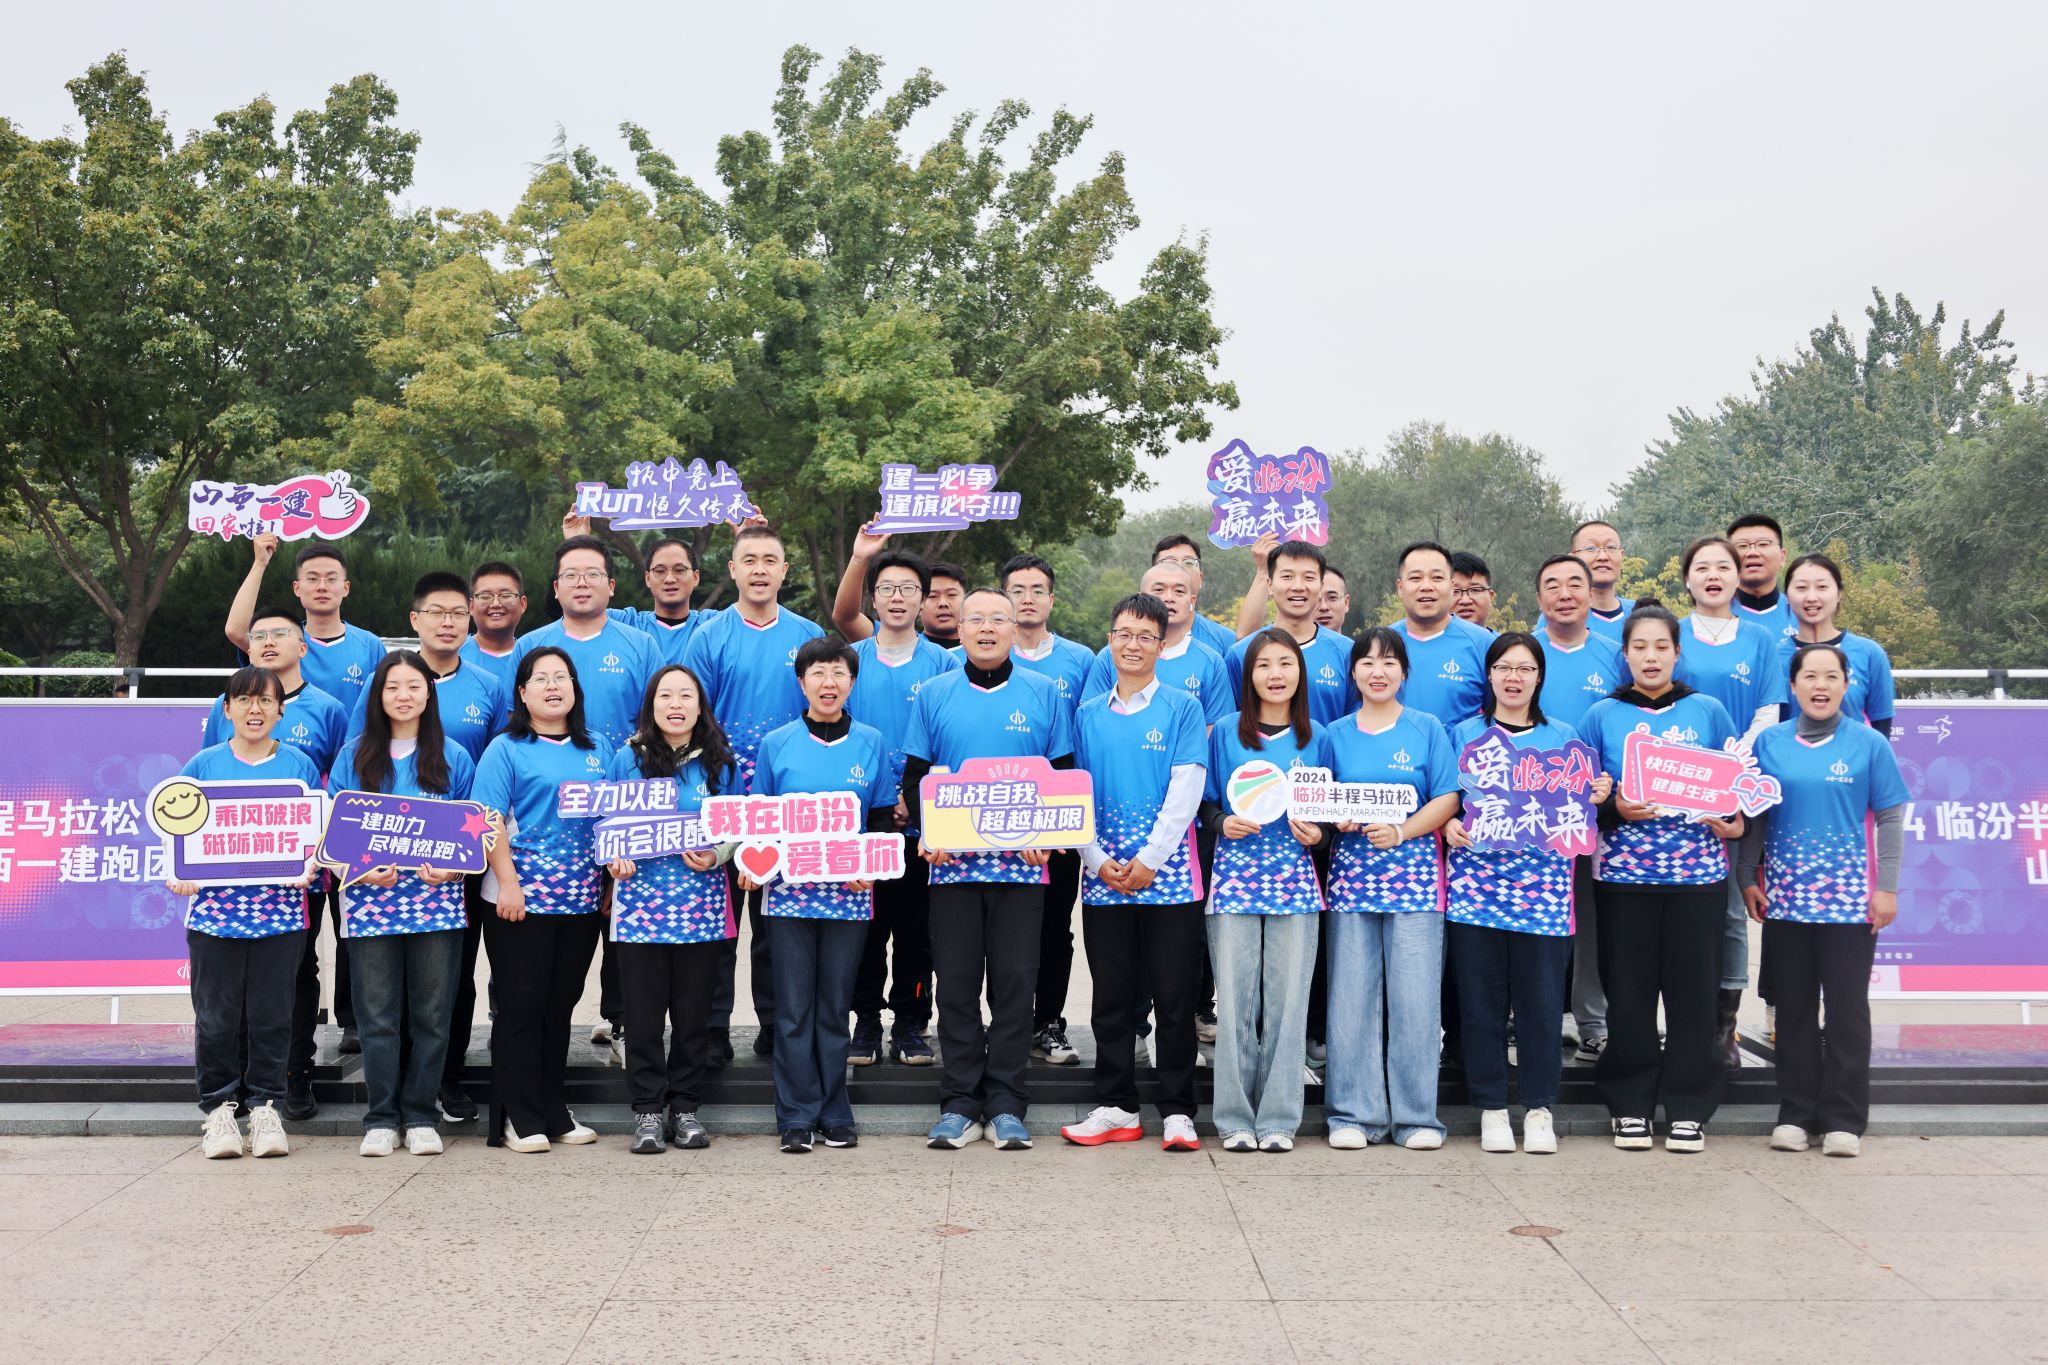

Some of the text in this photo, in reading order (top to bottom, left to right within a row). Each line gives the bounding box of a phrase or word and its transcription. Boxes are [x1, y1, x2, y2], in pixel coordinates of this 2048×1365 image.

[1214, 446, 1325, 494] 爱临汾
[1216, 495, 1321, 541] 赢未来
[1294, 772, 1327, 783] 2024
[1467, 735, 1595, 794] 爱临汾
[1644, 755, 1713, 782] 快乐运动
[562, 780, 676, 813] 全力以赴
[936, 783, 1036, 807] 挑战自我
[1293, 786, 1412, 805] 临汾半程马拉松
[215, 803, 312, 827] 乘风破浪
[340, 811, 426, 835] 一建助力
[708, 797, 855, 836] 我在临汾
[979, 807, 1083, 832] 超越极限
[1293, 806, 1401, 817] LINFEN HALF MARATHON
[1468, 794, 1590, 849] 赢未来
[1936, 801, 2048, 841] 临汾半
[202, 832, 299, 855] 砥砺前行
[367, 834, 456, 860] 尽情燃跑
[787, 838, 900, 877] 爱着你
